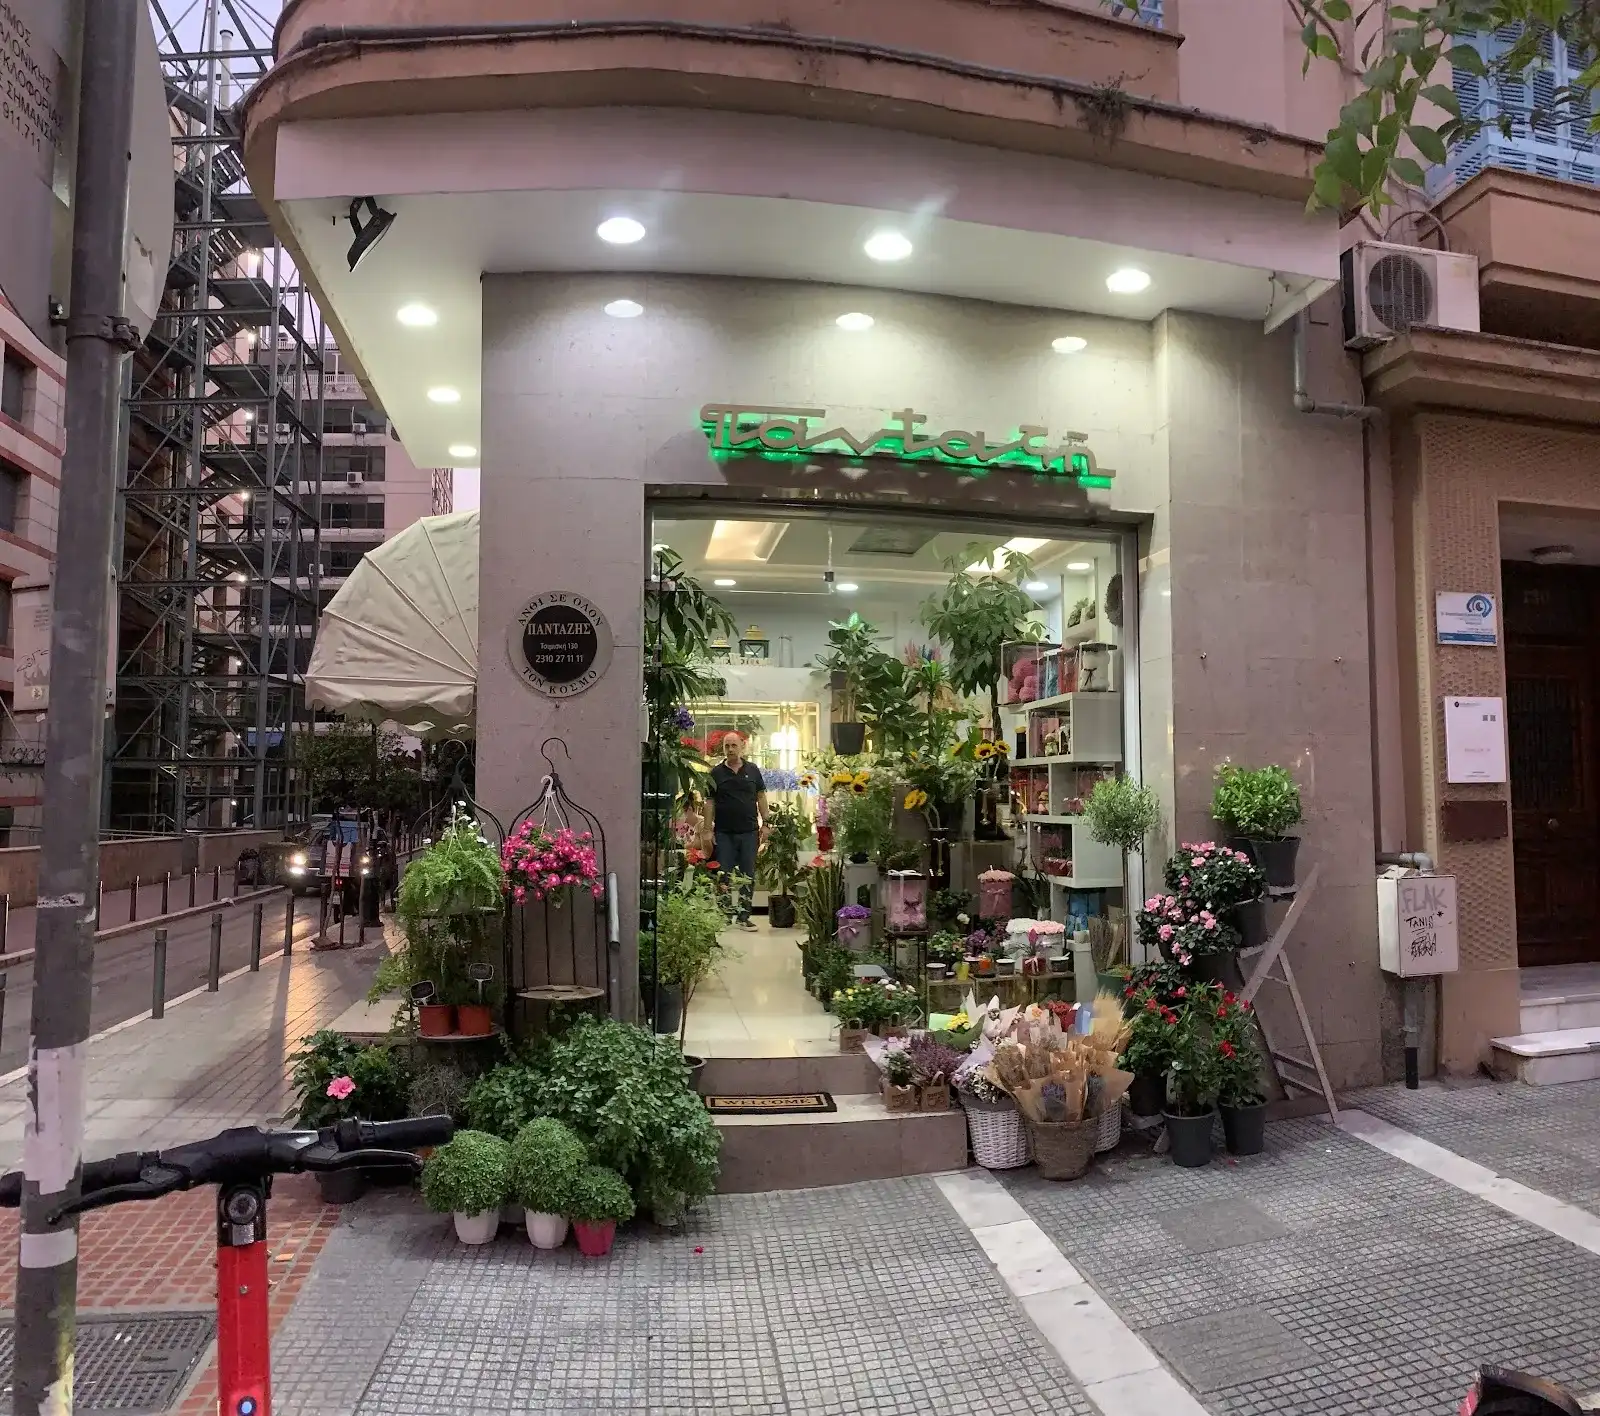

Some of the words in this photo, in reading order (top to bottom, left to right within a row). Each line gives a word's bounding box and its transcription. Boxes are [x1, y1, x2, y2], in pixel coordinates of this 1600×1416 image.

[550, 594, 567, 602] ΣΕ
[573, 597, 603, 627] ΟΛΟΝ
[527, 622, 591, 635] ΠΑΝΤΑΖΗΣ
[535, 654, 554, 663] 2310
[555, 654, 565, 663] 27
[566, 654, 574, 663] 11
[575, 654, 584, 663] 11
[523, 666, 545, 688] ΤΟΝ
[548, 670, 597, 694] ΚΟΣΜΟ
